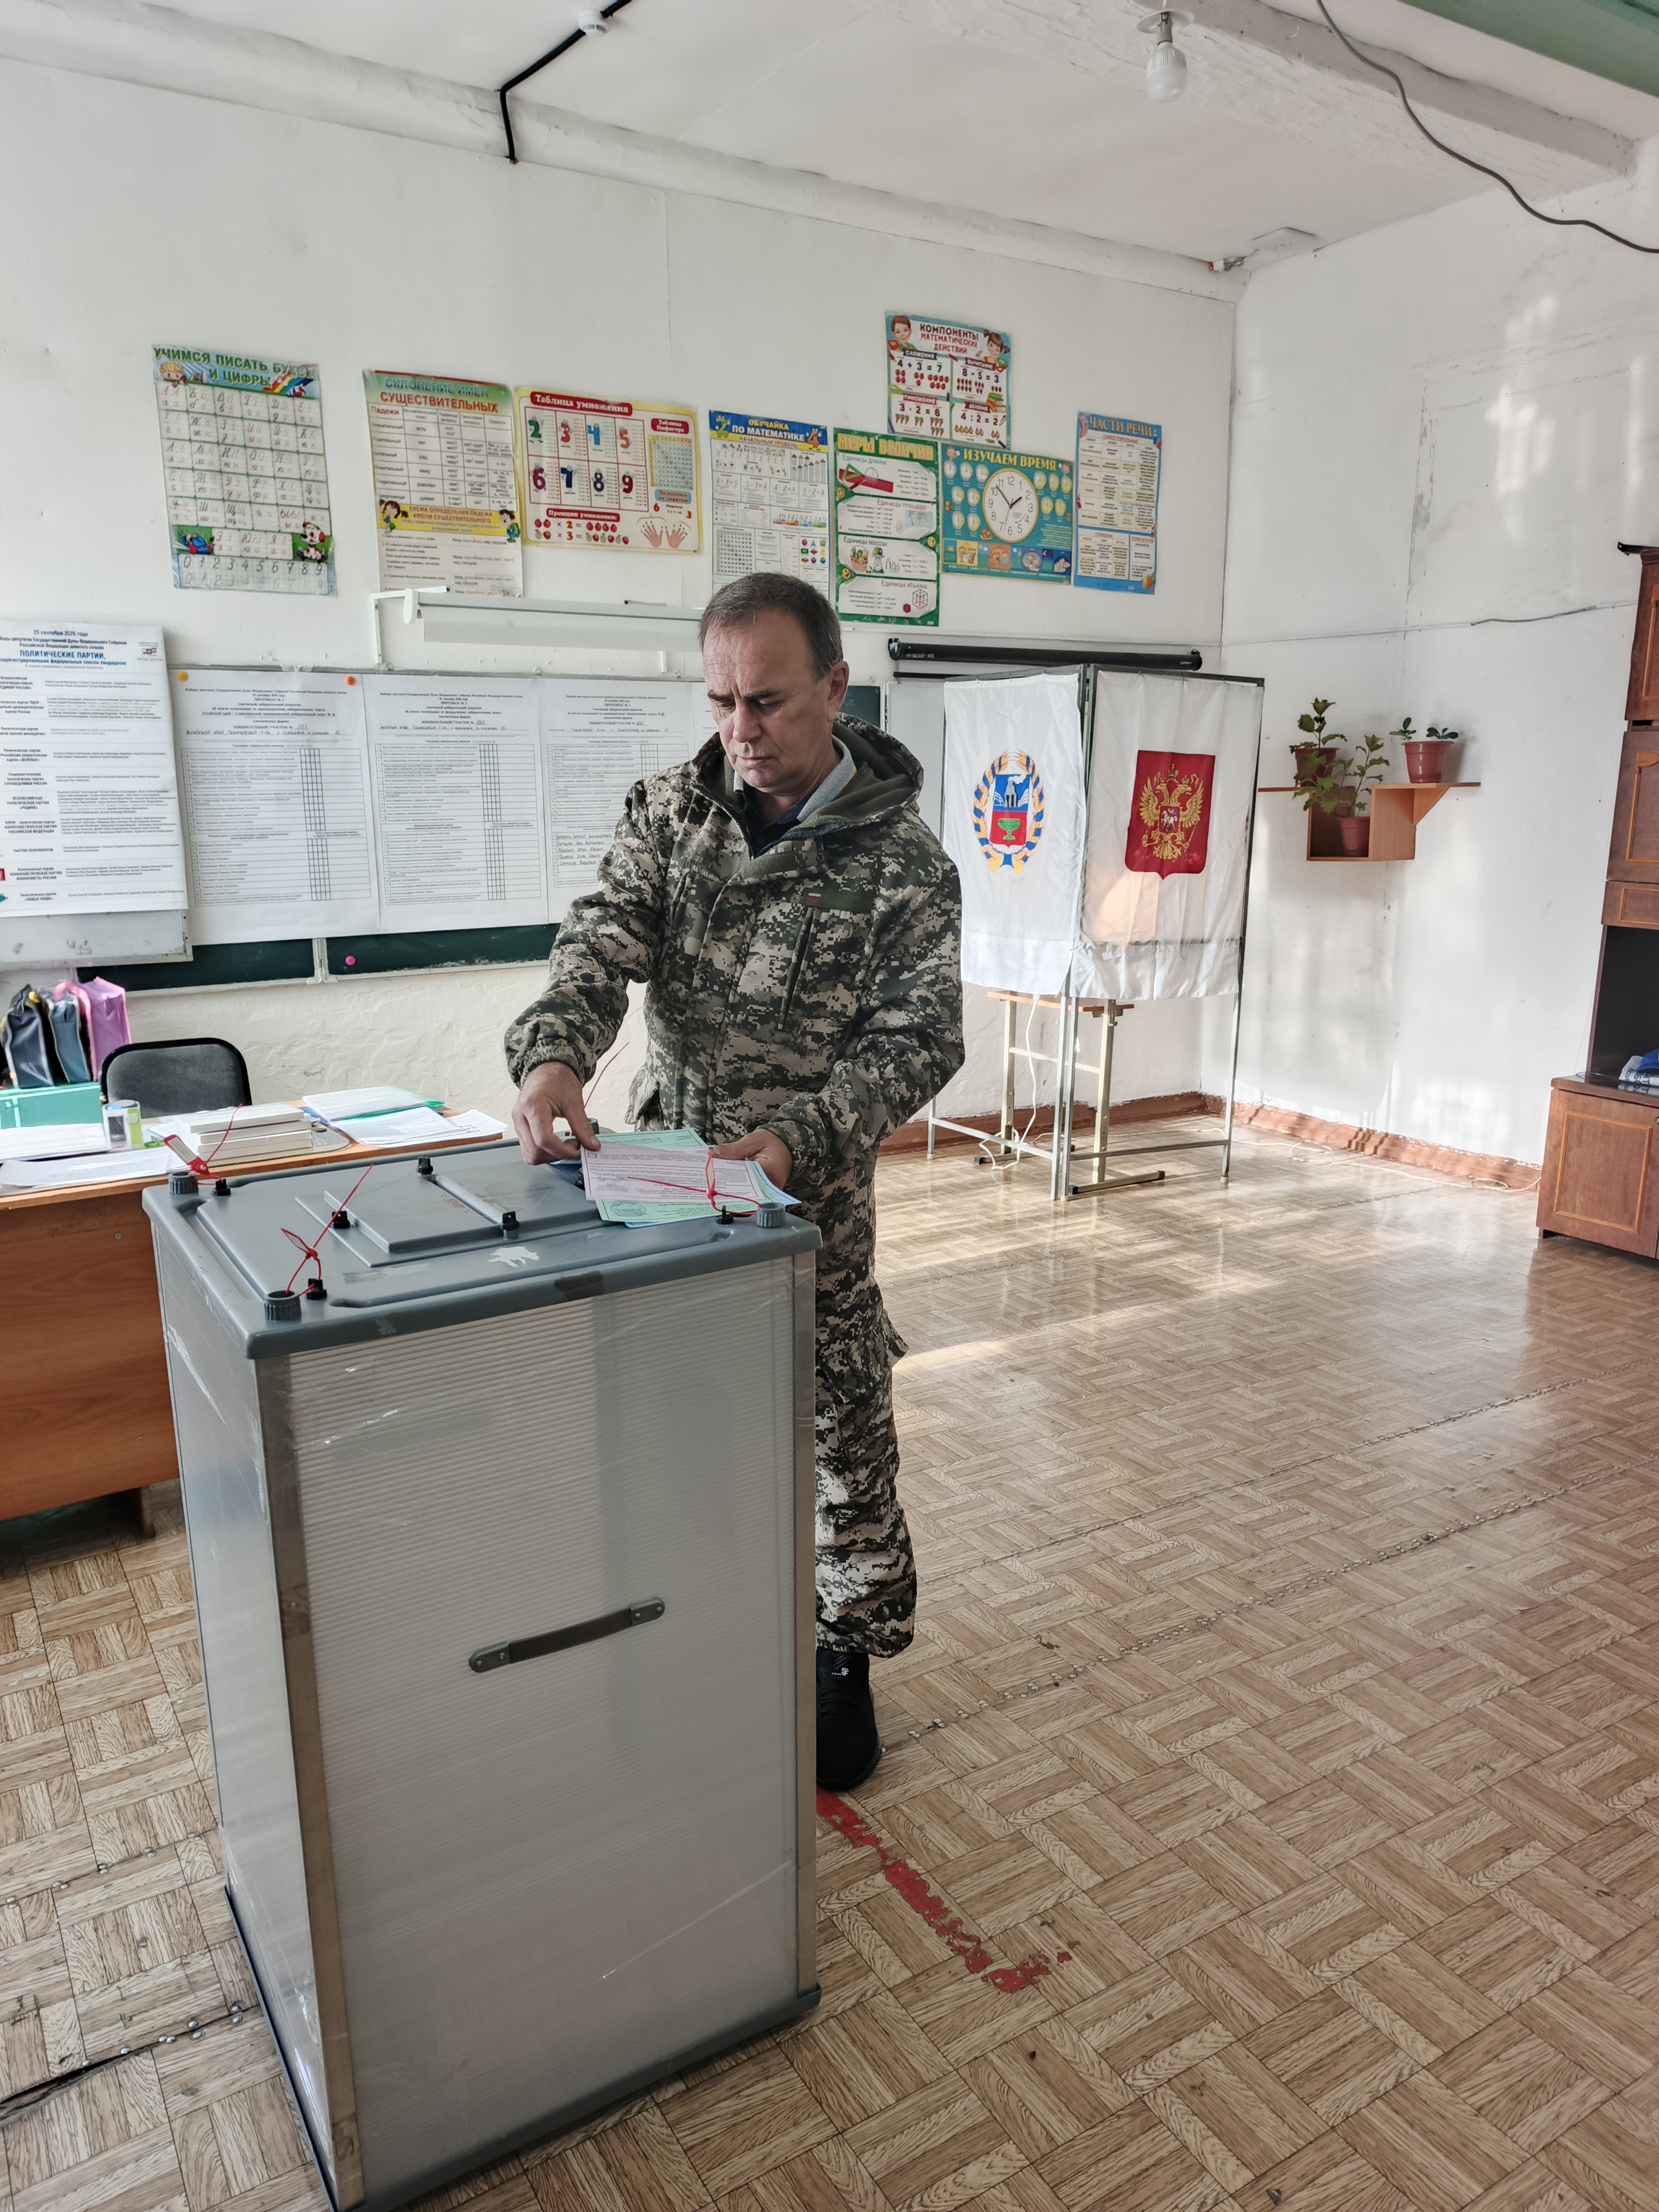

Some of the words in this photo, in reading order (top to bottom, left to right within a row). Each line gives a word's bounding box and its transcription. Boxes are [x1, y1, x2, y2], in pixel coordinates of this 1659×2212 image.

[920, 323, 979, 340] КОМПОНЕНТЫ
[921, 332, 978, 348] МАТЕМАТИЧЕСКИХ
[934, 343, 967, 354] ДЕЙСТВИЙ
[154, 347, 210, 362] УЧИМСЯ
[216, 355, 268, 371] ПИСАТЬ
[905, 350, 935, 359] СЛОЖЕНИЕ
[210, 369, 218, 380] И
[385, 377, 454, 393] СКЛОНЕНИЕ
[458, 386, 488, 397] ИМЕН
[380, 391, 498, 413] СУЩЕСТВИТЕЛЬНЫХ
[536, 394, 574, 408] Таблица
[576, 401, 628, 413] умножения
[905, 394, 936, 404] УМНОЖЕНИЕ
[371, 406, 399, 415] Падежи
[977, 415, 981, 423] 2
[749, 419, 789, 431] ОБУЧАЙКА
[1089, 417, 1124, 433] ЧАСТИ
[1126, 423, 1152, 437] РЕЧИ
[528, 419, 541, 439] 2
[561, 421, 570, 442] 3
[588, 425, 600, 445] 4
[620, 429, 630, 449] 5
[731, 425, 745, 434] ПО
[746, 427, 804, 442] МАТЕМАТИКЕ
[739, 436, 773, 445] НАЧАЛЬНЫЙ
[774, 439, 798, 448] УРОВЕНЬ
[837, 433, 875, 451] МЕРЫ
[879, 439, 934, 461] ВЕЛИЧИН
[842, 454, 867, 463] Единицы
[963, 449, 1017, 465] ИЗУЧАЕМ
[1020, 456, 1056, 471] ВРЕМЯ
[533, 468, 546, 489] 6
[561, 467, 573, 488] 7
[593, 472, 604, 492] 8
[622, 474, 633, 493] 9
[998, 479, 1003, 488] 11
[1007, 476, 1015, 486] 12
[1019, 481, 1022, 489] 1
[991, 487, 998, 496] 10
[1026, 491, 1030, 499] 2
[902, 501, 928, 510] площади:
[988, 499, 993, 508] 9
[1029, 503, 1033, 512] 3
[434, 515, 491, 523] СУЩЕСТВИТЕЛЬНОГО
[992, 512, 996, 521] 8
[999, 522, 1003, 531] 7
[1007, 526, 1012, 535] 6
[1017, 524, 1022, 533] 5
[843, 536, 868, 545] Единицы
[184, 556, 191, 567] 0
[200, 557, 204, 567] 1
[213, 559, 220, 569] 2
[228, 559, 234, 570] 3
[242, 559, 248, 570] 4
[257, 560, 263, 572] 5
[272, 561, 278, 573] 6
[288, 562, 294, 573] 7
[302, 562, 307, 574] 8
[316, 564, 322, 575] 9
[77, 650, 105, 659] ПАРТИИ,
